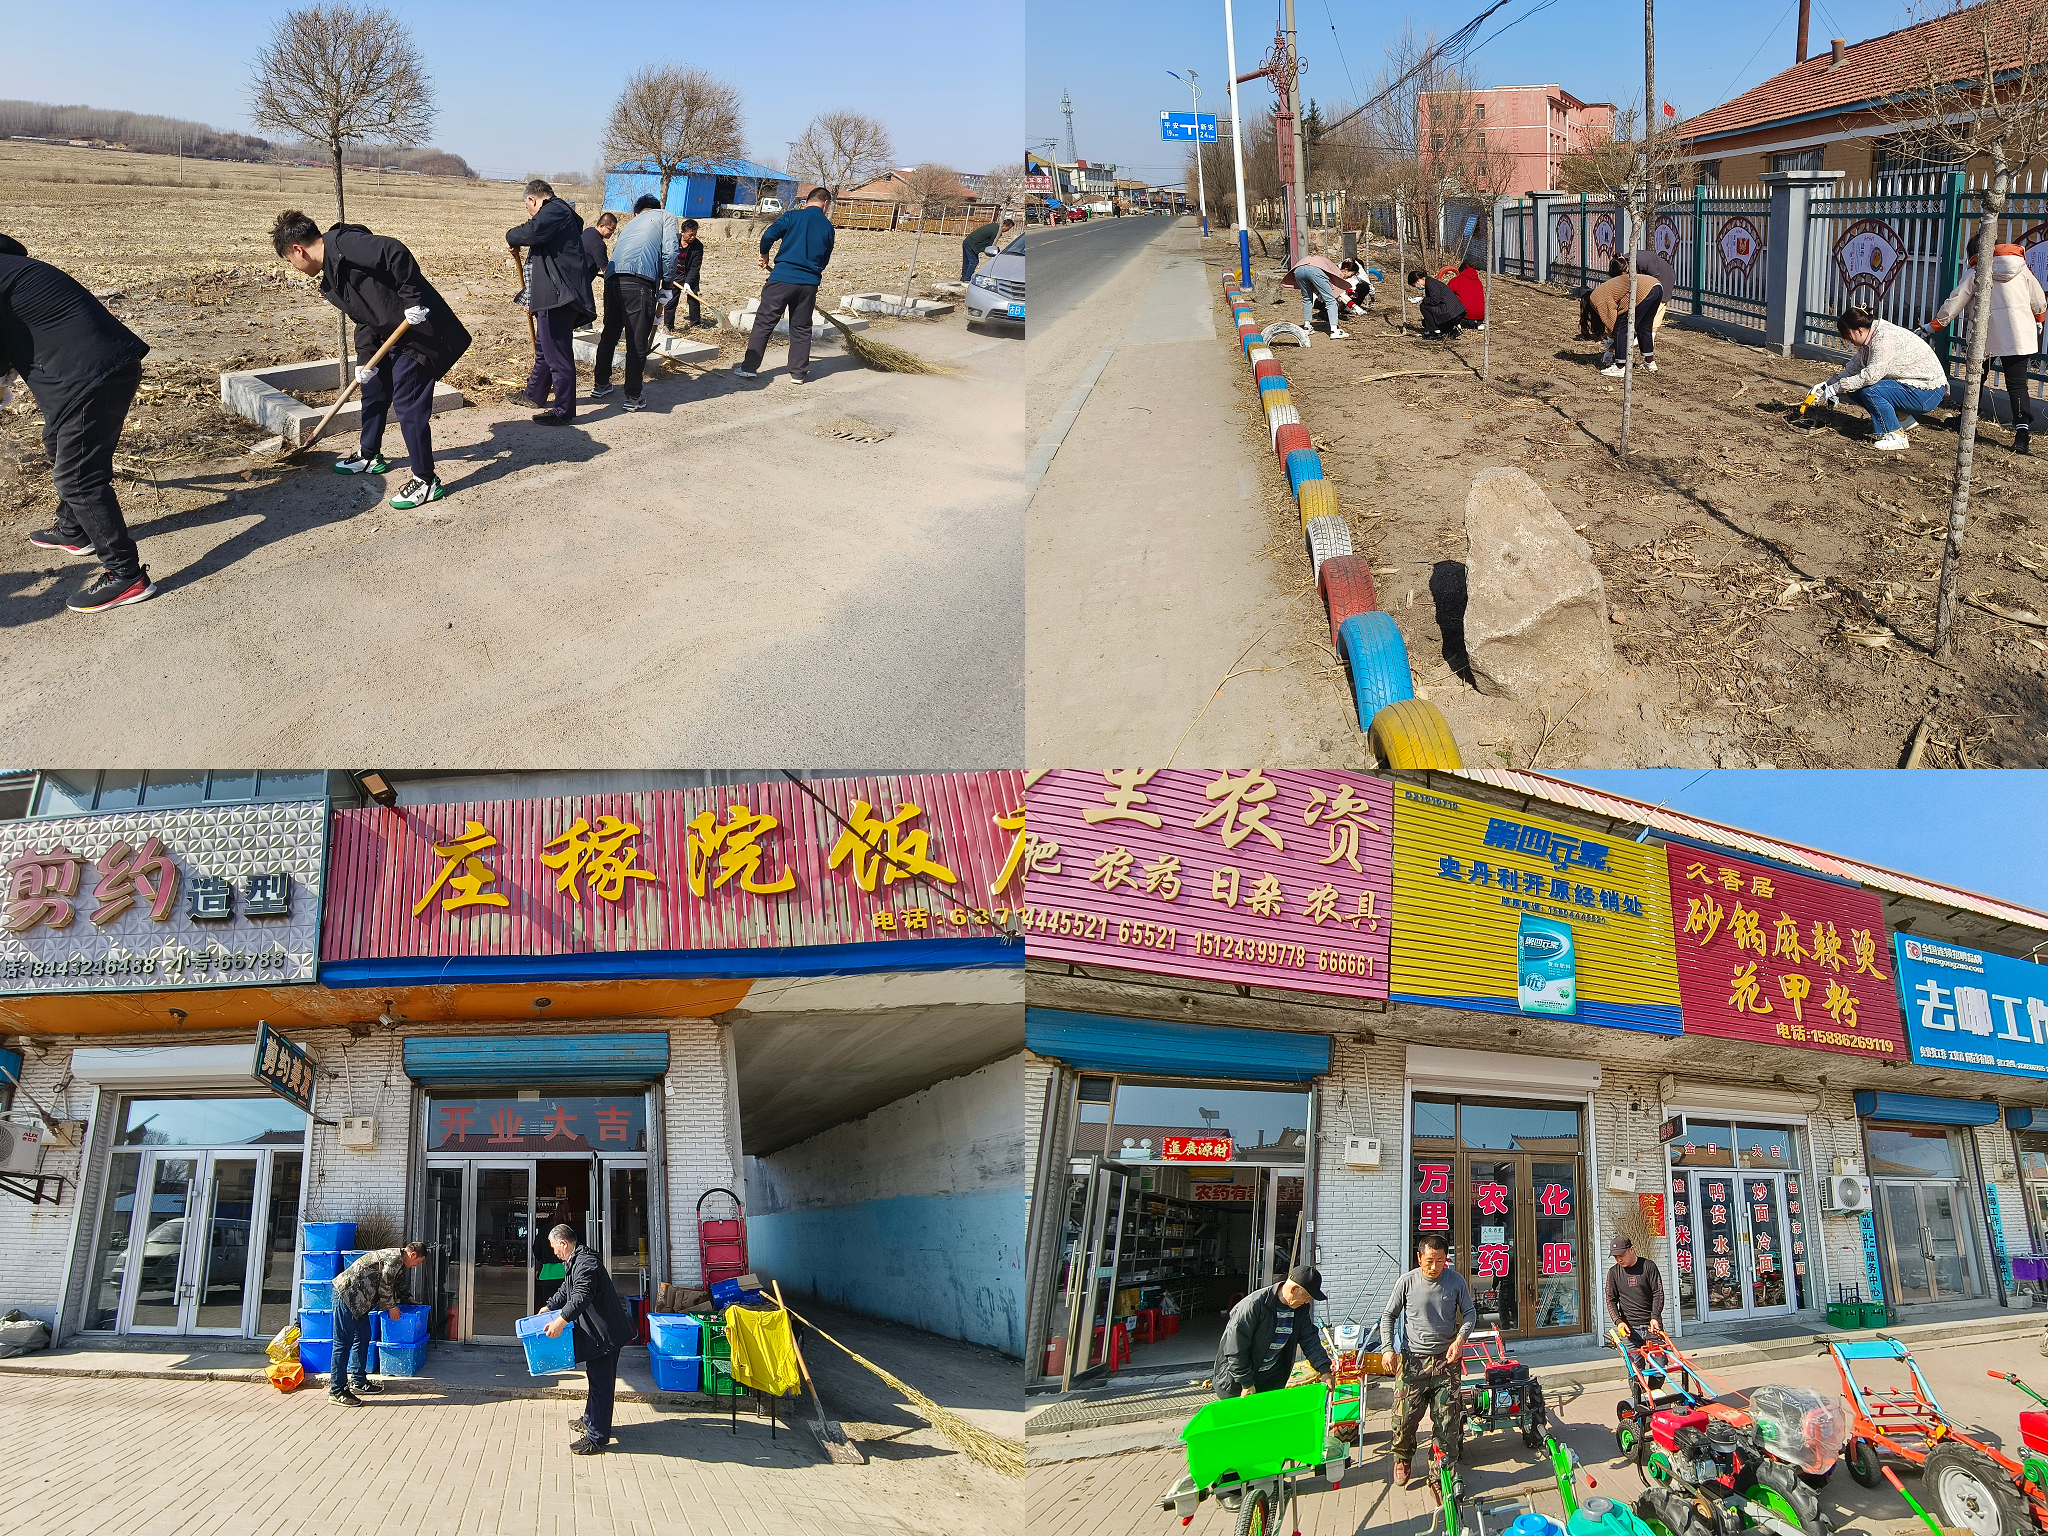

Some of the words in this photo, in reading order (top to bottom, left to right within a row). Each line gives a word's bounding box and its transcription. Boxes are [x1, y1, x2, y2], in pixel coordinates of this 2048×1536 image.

[1025, 768, 1382, 874] 里农资
[4, 836, 179, 932] 剪约
[185, 872, 292, 922] 造型
[1089, 846, 1183, 901] 农药
[1211, 866, 1285, 917] 日杂
[1303, 883, 1382, 932] 农具
[1436, 854, 1643, 917] 史丹利开原经销处
[1686, 862, 1776, 900] 久香居
[1118, 919, 1178, 951] 65521
[1194, 930, 1307, 969] 15124399778
[1319, 948, 1375, 978] 666661
[1682, 892, 1890, 982] 砂锅麻辣烫
[1729, 960, 1860, 1030] 花甲粉
[1915, 979, 2048, 1045] 去哪工作
[1776, 1022, 1894, 1054] 电话:15886269119
[439, 1105, 632, 1144] 开业大吉
[1683, 1140, 1717, 1156] 金日
[1751, 1143, 1781, 1158] 大吉
[1418, 1164, 1450, 1231] 万里
[1478, 1182, 1510, 1277] 农药
[1540, 1183, 1572, 1275] 化肥
